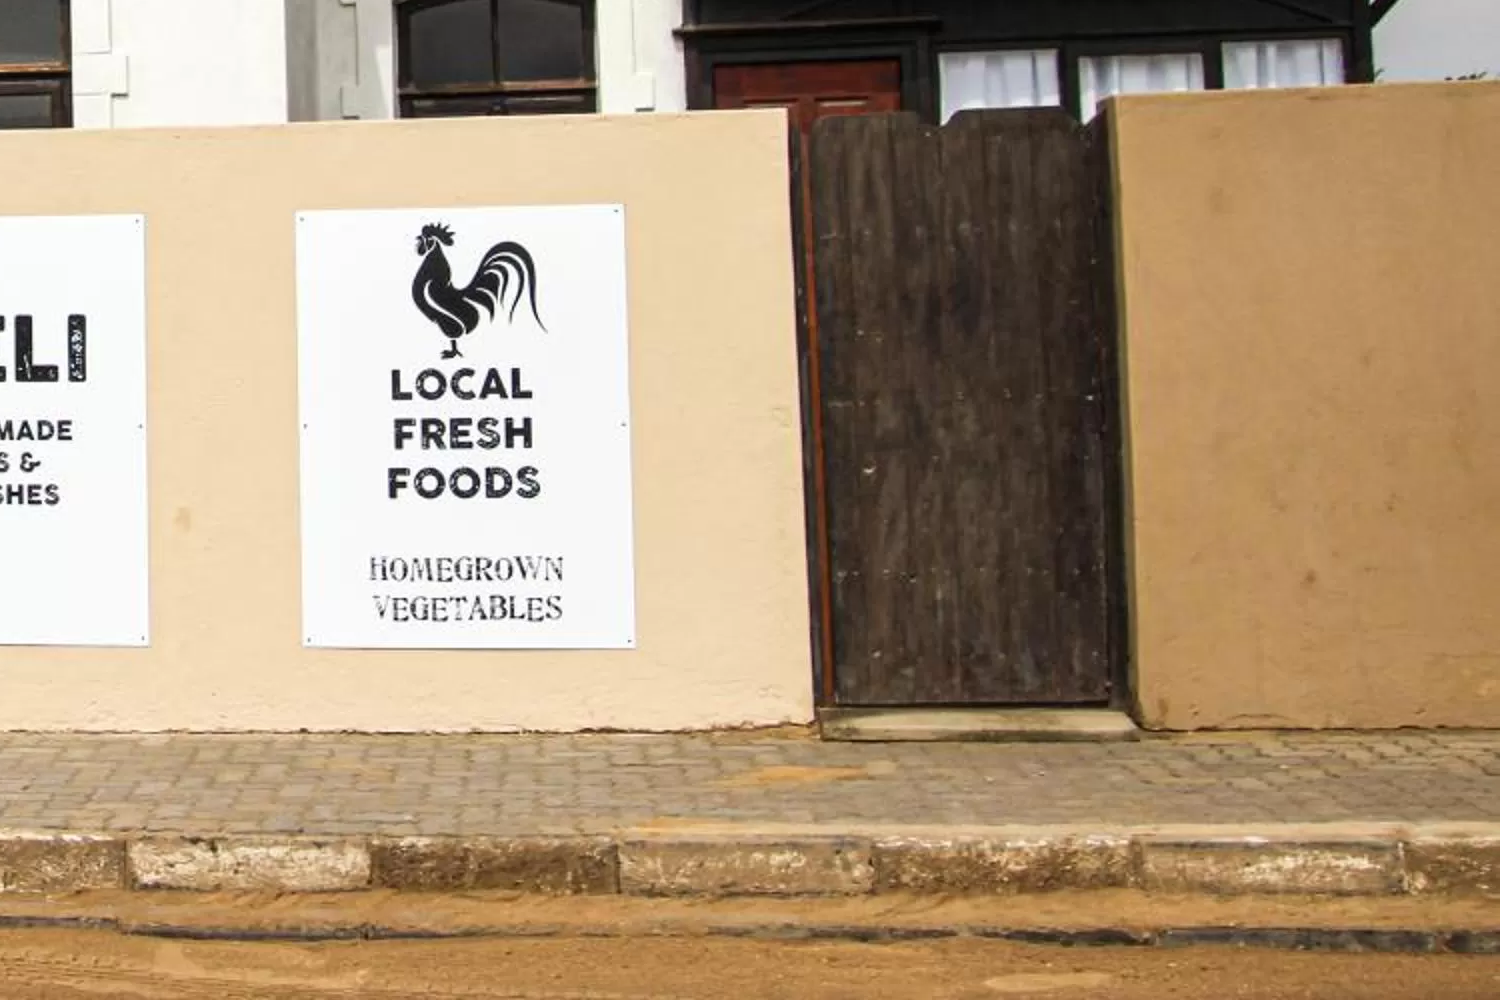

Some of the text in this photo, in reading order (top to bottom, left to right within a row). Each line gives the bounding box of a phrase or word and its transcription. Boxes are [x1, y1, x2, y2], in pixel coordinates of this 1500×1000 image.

[390, 367, 534, 401] LOCAL
[392, 417, 534, 451] FRESH
[19, 452, 42, 473] &
[386, 465, 542, 499] FOODS
[368, 555, 565, 583] HOMEGROWN
[372, 594, 564, 622] VEGETABLES
